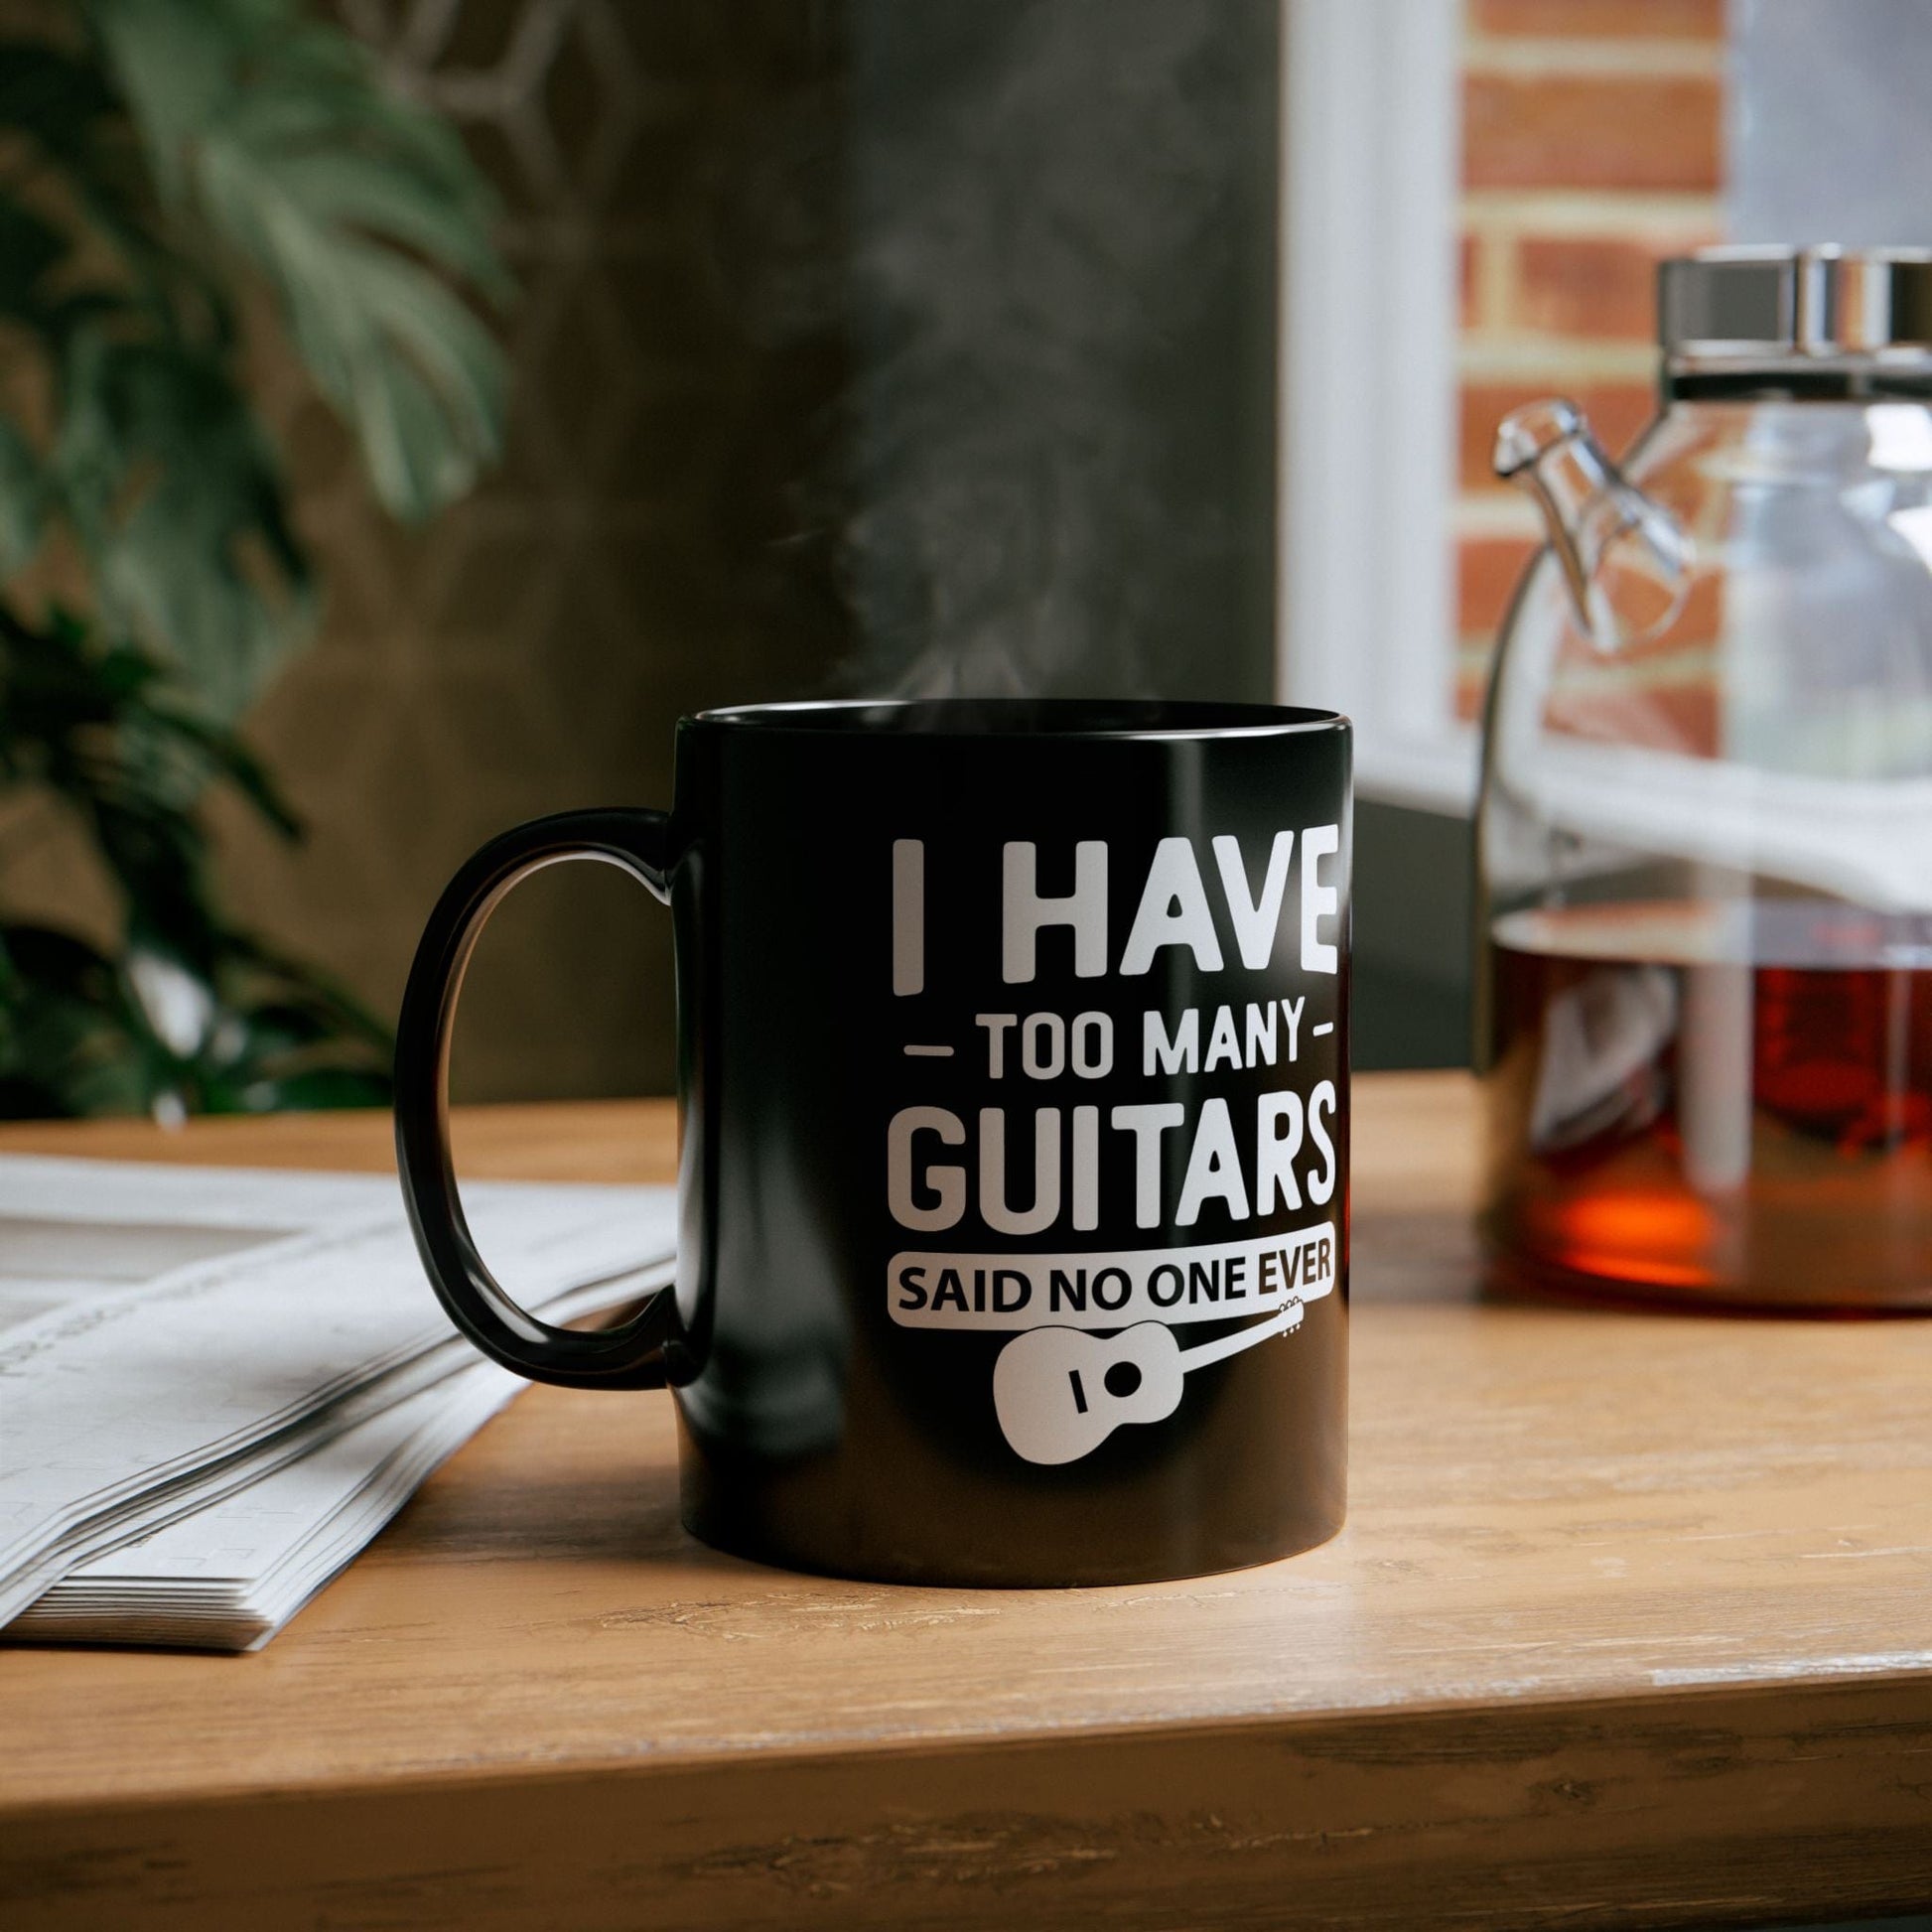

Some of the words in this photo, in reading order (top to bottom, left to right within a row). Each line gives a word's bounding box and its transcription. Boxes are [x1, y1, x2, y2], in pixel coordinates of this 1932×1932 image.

[893, 838, 924, 997] I
[1002, 823, 1339, 984] HAVE
[975, 1012, 1114, 1080] TOO
[1143, 996, 1306, 1076] MANY
[887, 1079, 1336, 1235] GUITARS
[897, 1266, 1032, 1312] SAID
[1049, 1268, 1132, 1312] NO
[1147, 1256, 1246, 1308] ONE
[1258, 1237, 1331, 1296] EVER
